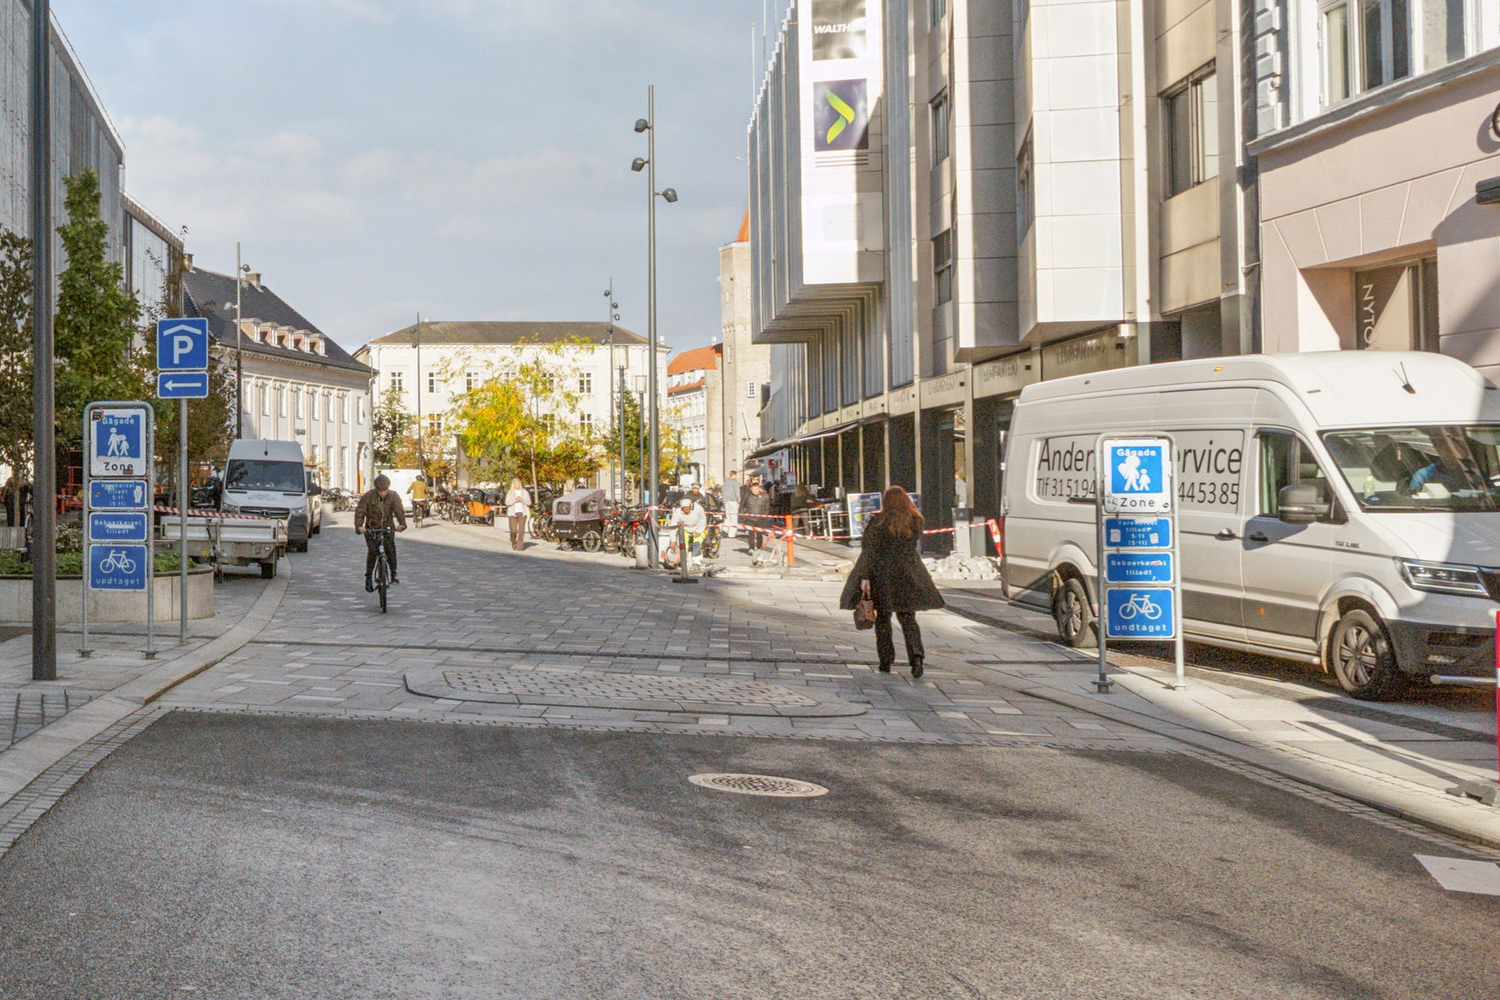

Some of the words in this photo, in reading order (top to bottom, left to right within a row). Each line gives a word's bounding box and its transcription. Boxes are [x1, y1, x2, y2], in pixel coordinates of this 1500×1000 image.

[813, 23, 860, 34] WALTH
[1362, 283, 1376, 350] NYTO
[173, 335, 194, 365] P
[102, 417, 135, 426] Gågade
[1037, 439, 1096, 472] Ander
[1177, 440, 1241, 474] rvice
[1116, 448, 1157, 457] Gågade
[103, 461, 134, 471] Zone
[1037, 477, 1049, 496] Tlf
[1120, 497, 1156, 508] Zone
[95, 577, 140, 586] undtaget
[1114, 623, 1168, 633] undtaget
